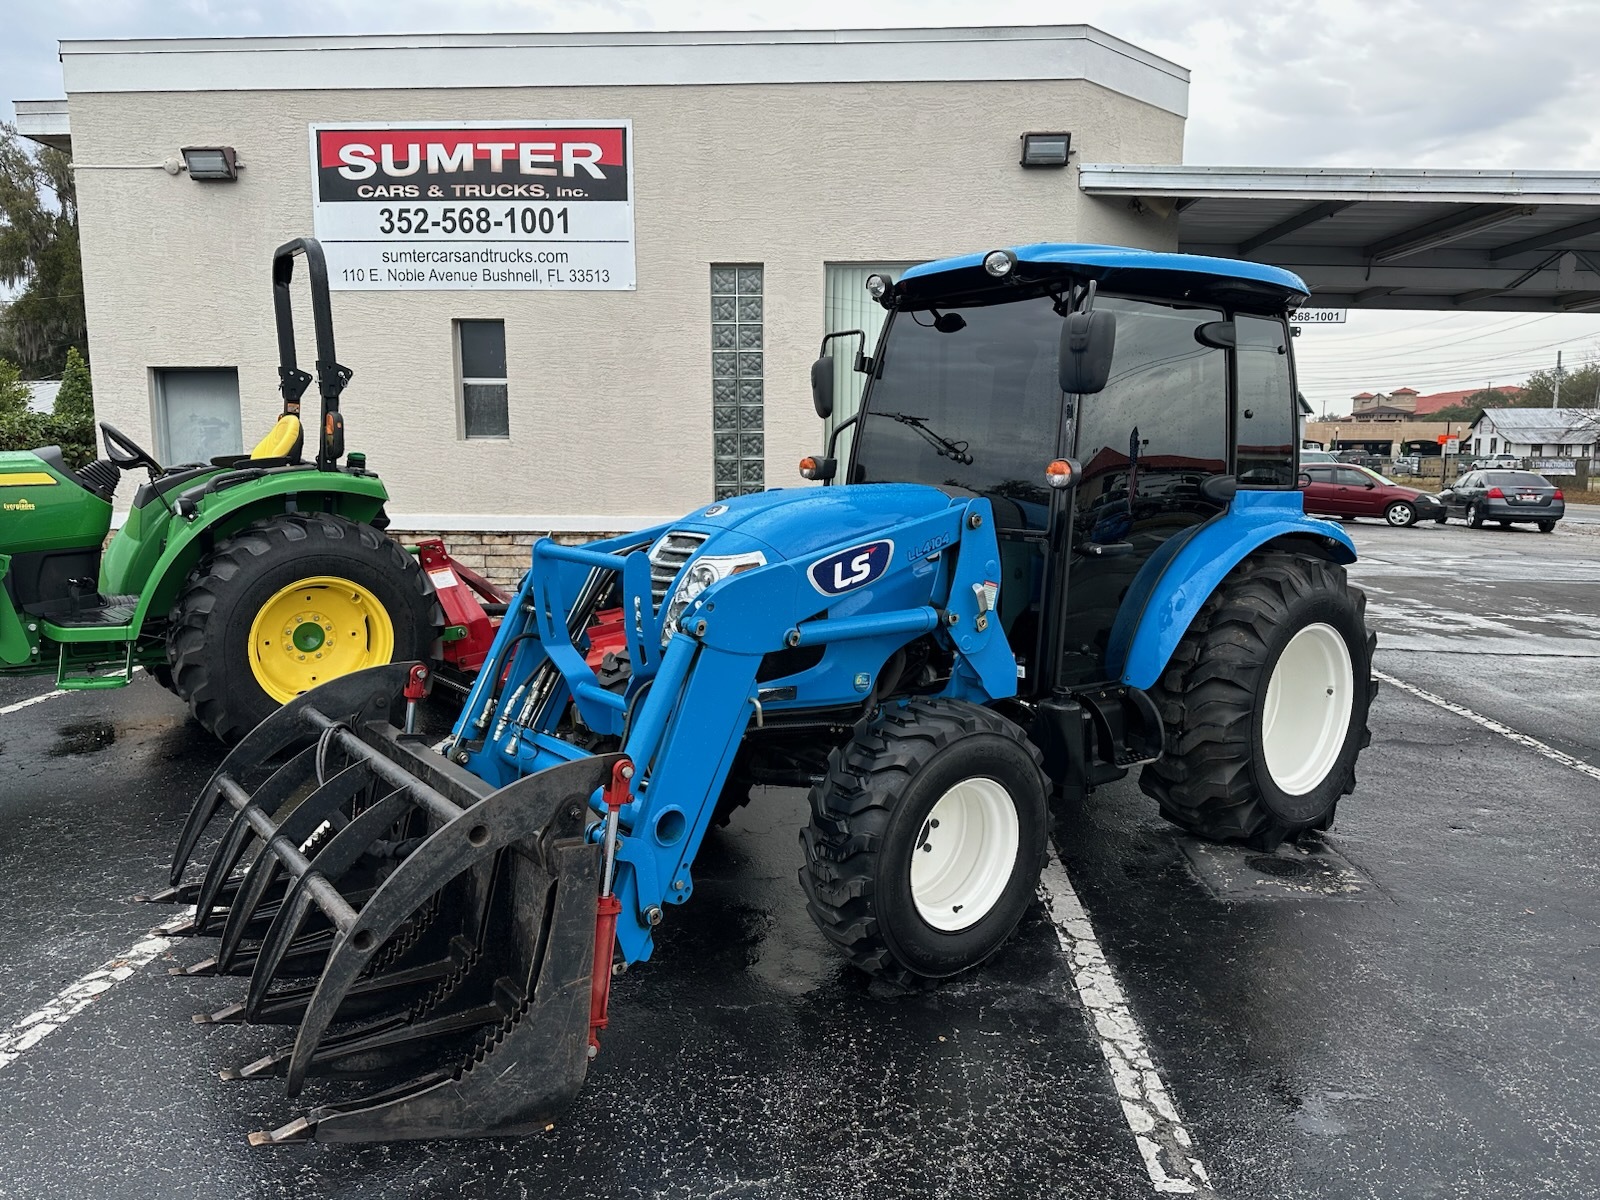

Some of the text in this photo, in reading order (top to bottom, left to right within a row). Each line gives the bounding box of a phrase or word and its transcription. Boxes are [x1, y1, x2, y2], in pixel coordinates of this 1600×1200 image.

[337, 142, 607, 181] SUMTER
[356, 184, 589, 199] CARS & TRUCKS, Inc.
[379, 207, 570, 235] 352-568-1001
[382, 249, 569, 264] sumtercarsandtrucks.com
[343, 269, 610, 284] 110 E. Noble Avenue Bushnell, FL 33513
[907, 531, 950, 561] LL4104
[834, 552, 871, 589] LS
